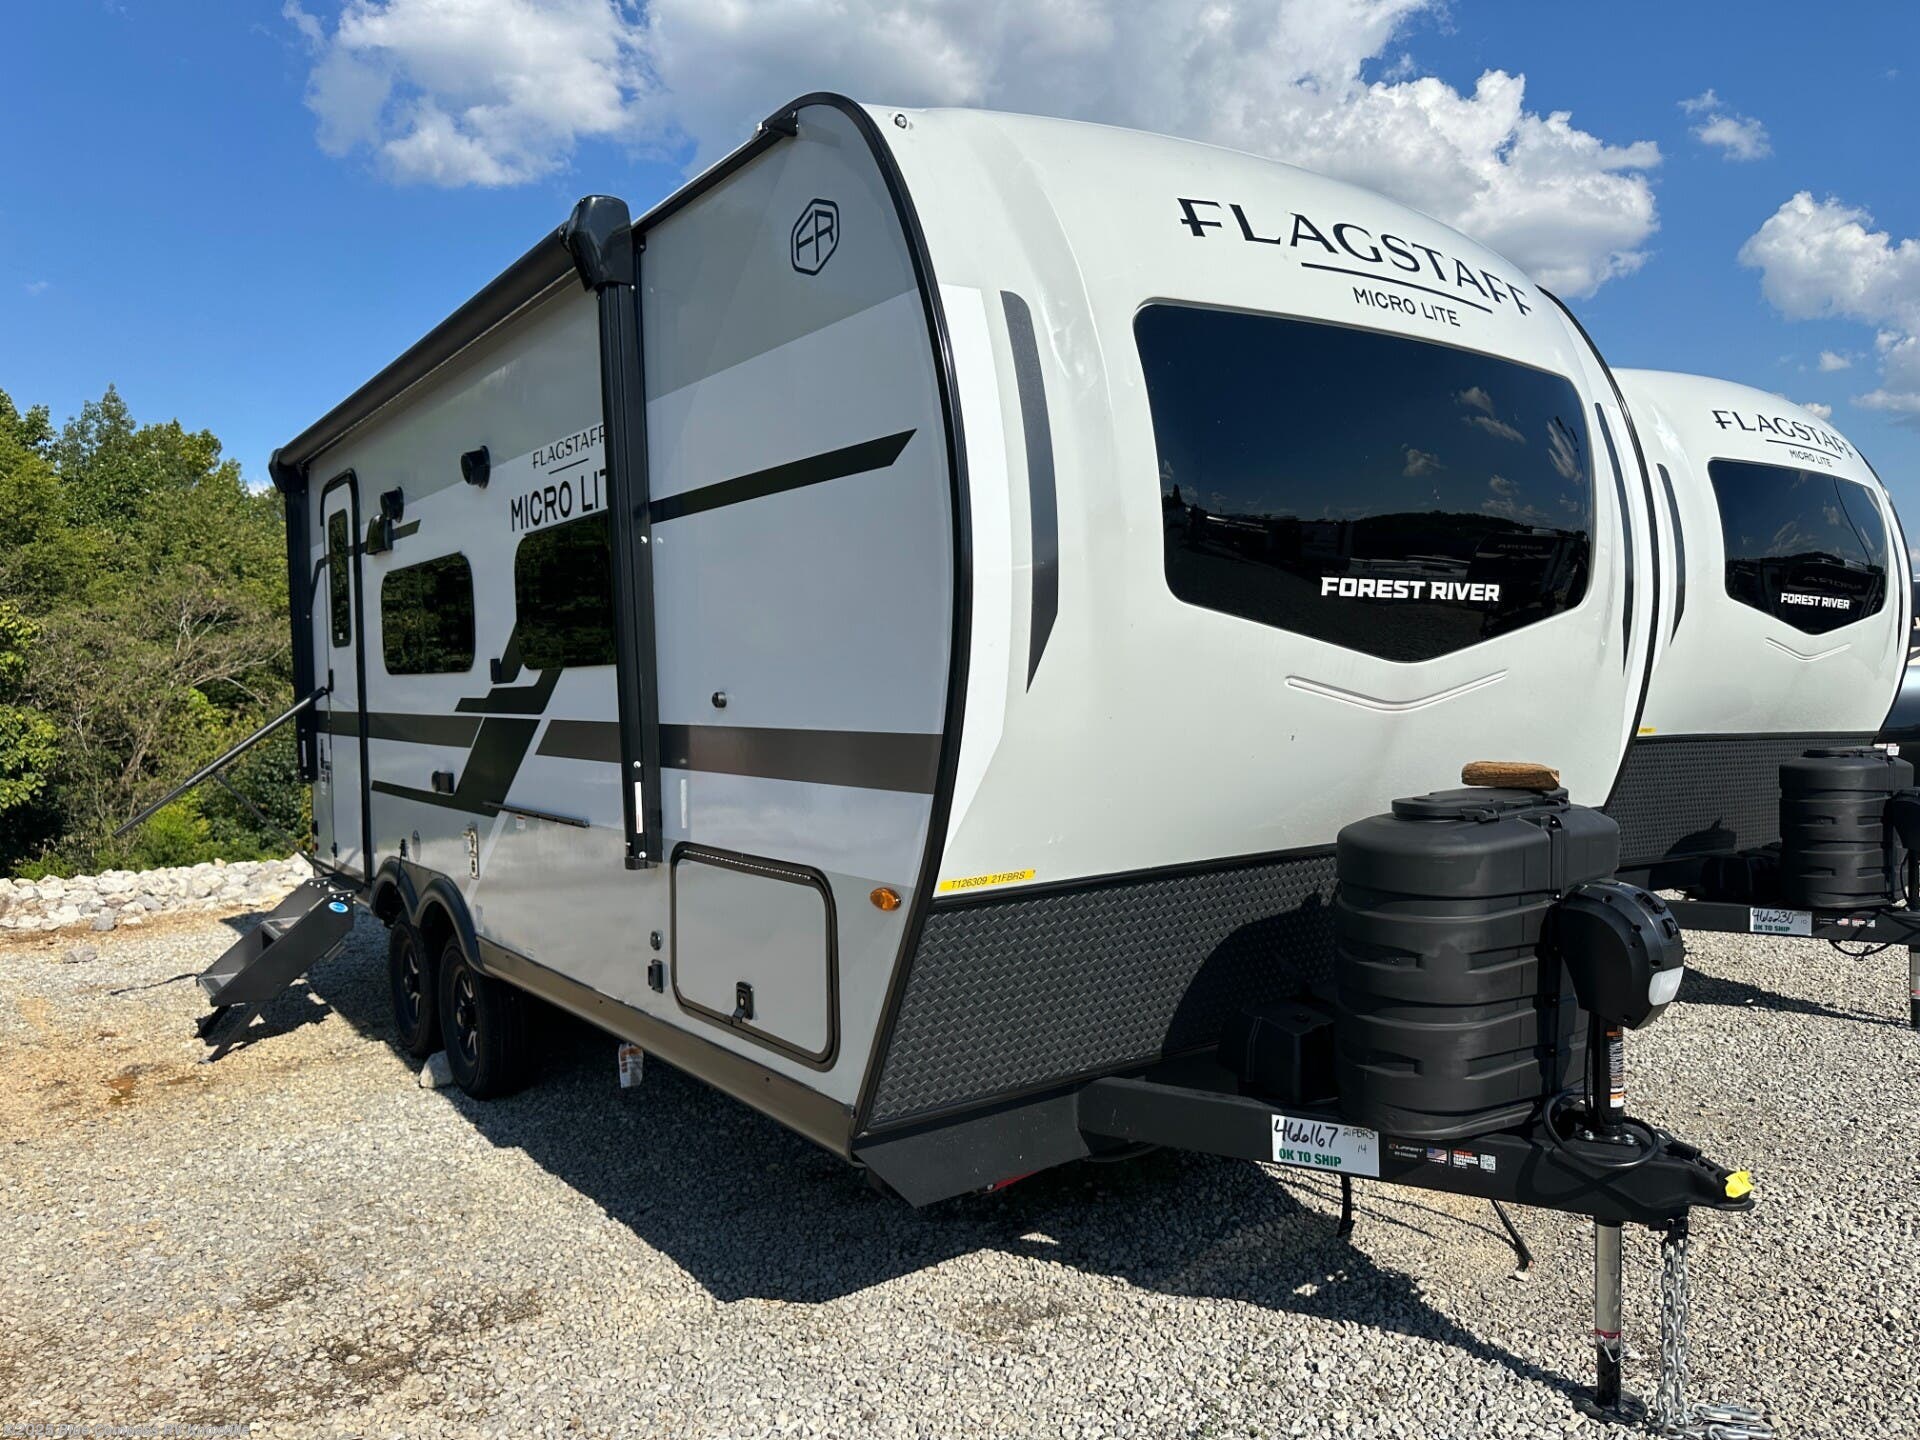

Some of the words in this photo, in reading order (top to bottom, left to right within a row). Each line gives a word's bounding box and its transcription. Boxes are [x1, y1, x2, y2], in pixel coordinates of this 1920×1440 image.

[1177, 197, 1532, 317] FLAGSTAFF
[1353, 286, 1419, 316] MICRO
[1421, 300, 1461, 327] LITE
[1713, 410, 1854, 458] FLAGSTAFF
[1789, 449, 1816, 462] MICRO
[1816, 455, 1833, 468] LITE
[511, 480, 573, 532] MICRO
[1321, 577, 1426, 599] FOREST
[1430, 581, 1500, 602] RIVER
[1781, 593, 1821, 607] FOREST
[1822, 597, 1850, 610] RIVER
[951, 877, 988, 889] T126309
[991, 871, 1025, 884] 21FBRS
[1274, 1119, 1339, 1149] 466167
[1279, 1148, 1294, 1161] OK
[1297, 1150, 1311, 1163] TO
[1315, 1154, 1342, 1167] SHIP
